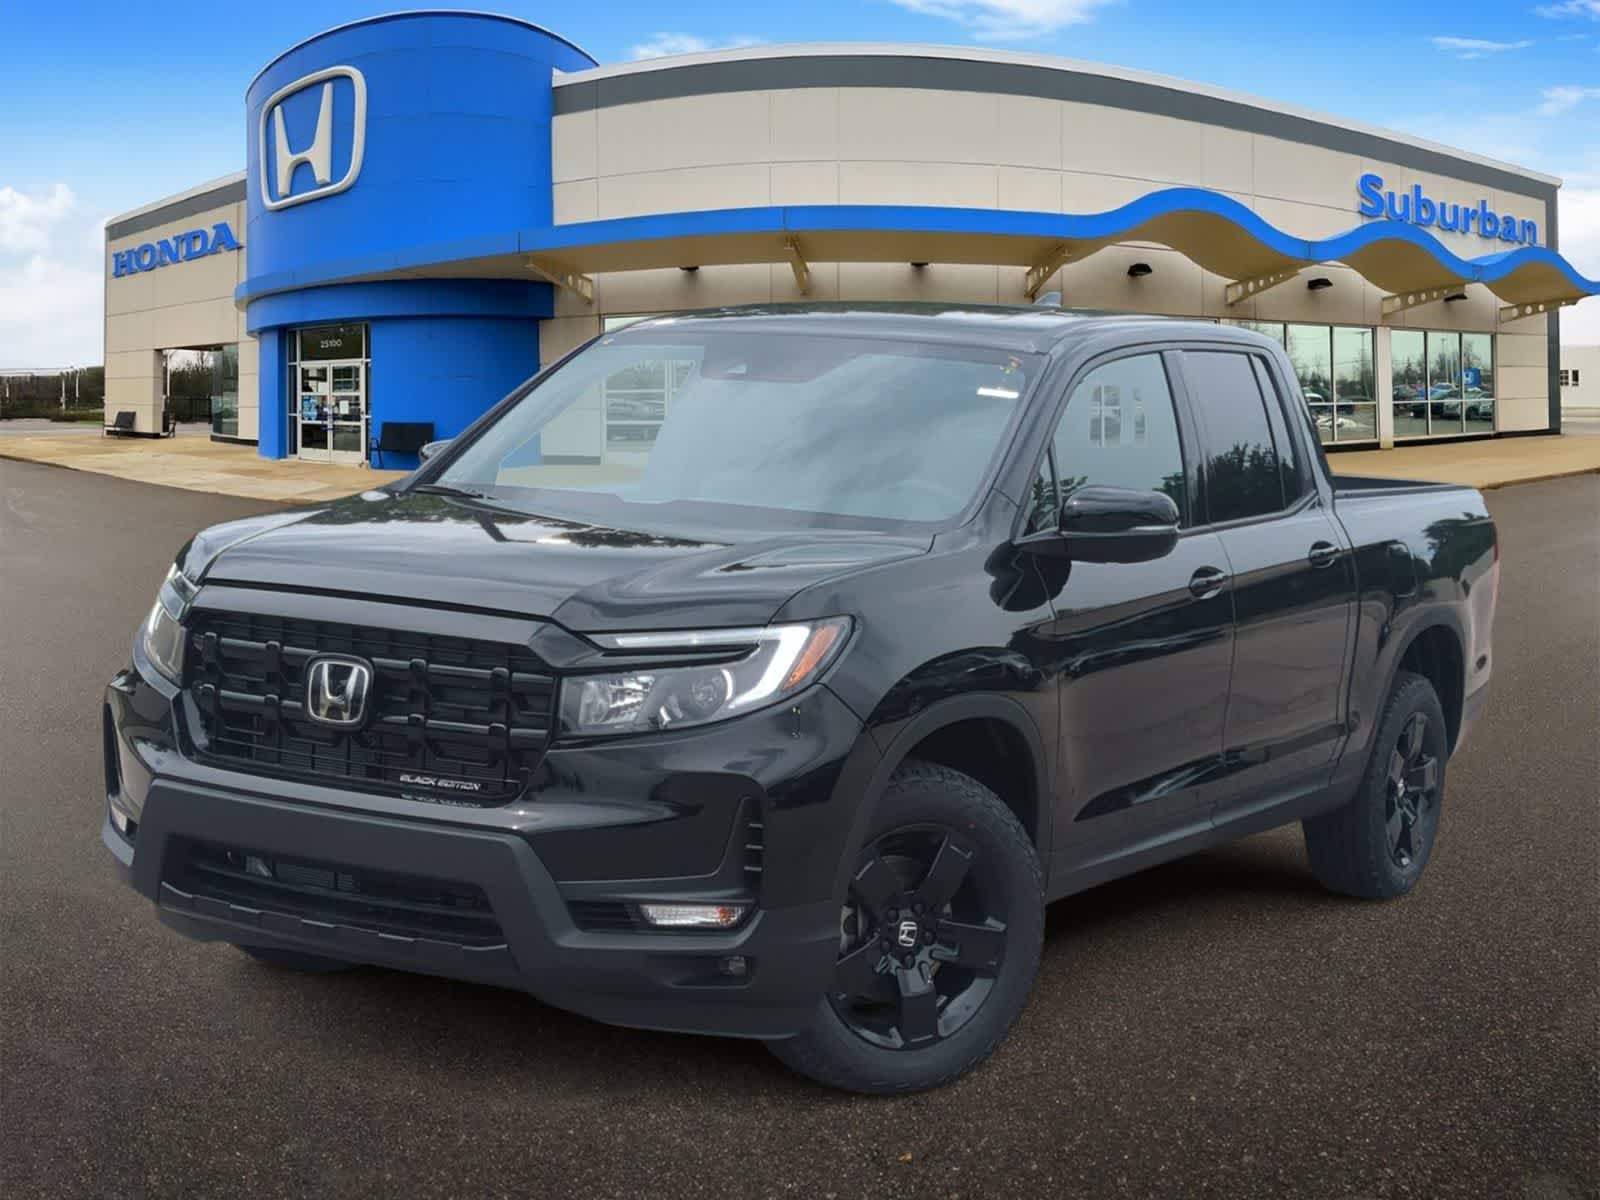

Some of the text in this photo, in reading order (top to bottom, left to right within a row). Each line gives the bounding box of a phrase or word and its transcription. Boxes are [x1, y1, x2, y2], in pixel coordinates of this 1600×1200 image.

[1357, 173, 1538, 245] Suburban
[112, 221, 241, 278] HONDA
[399, 774, 481, 791] BLACK EDITION
